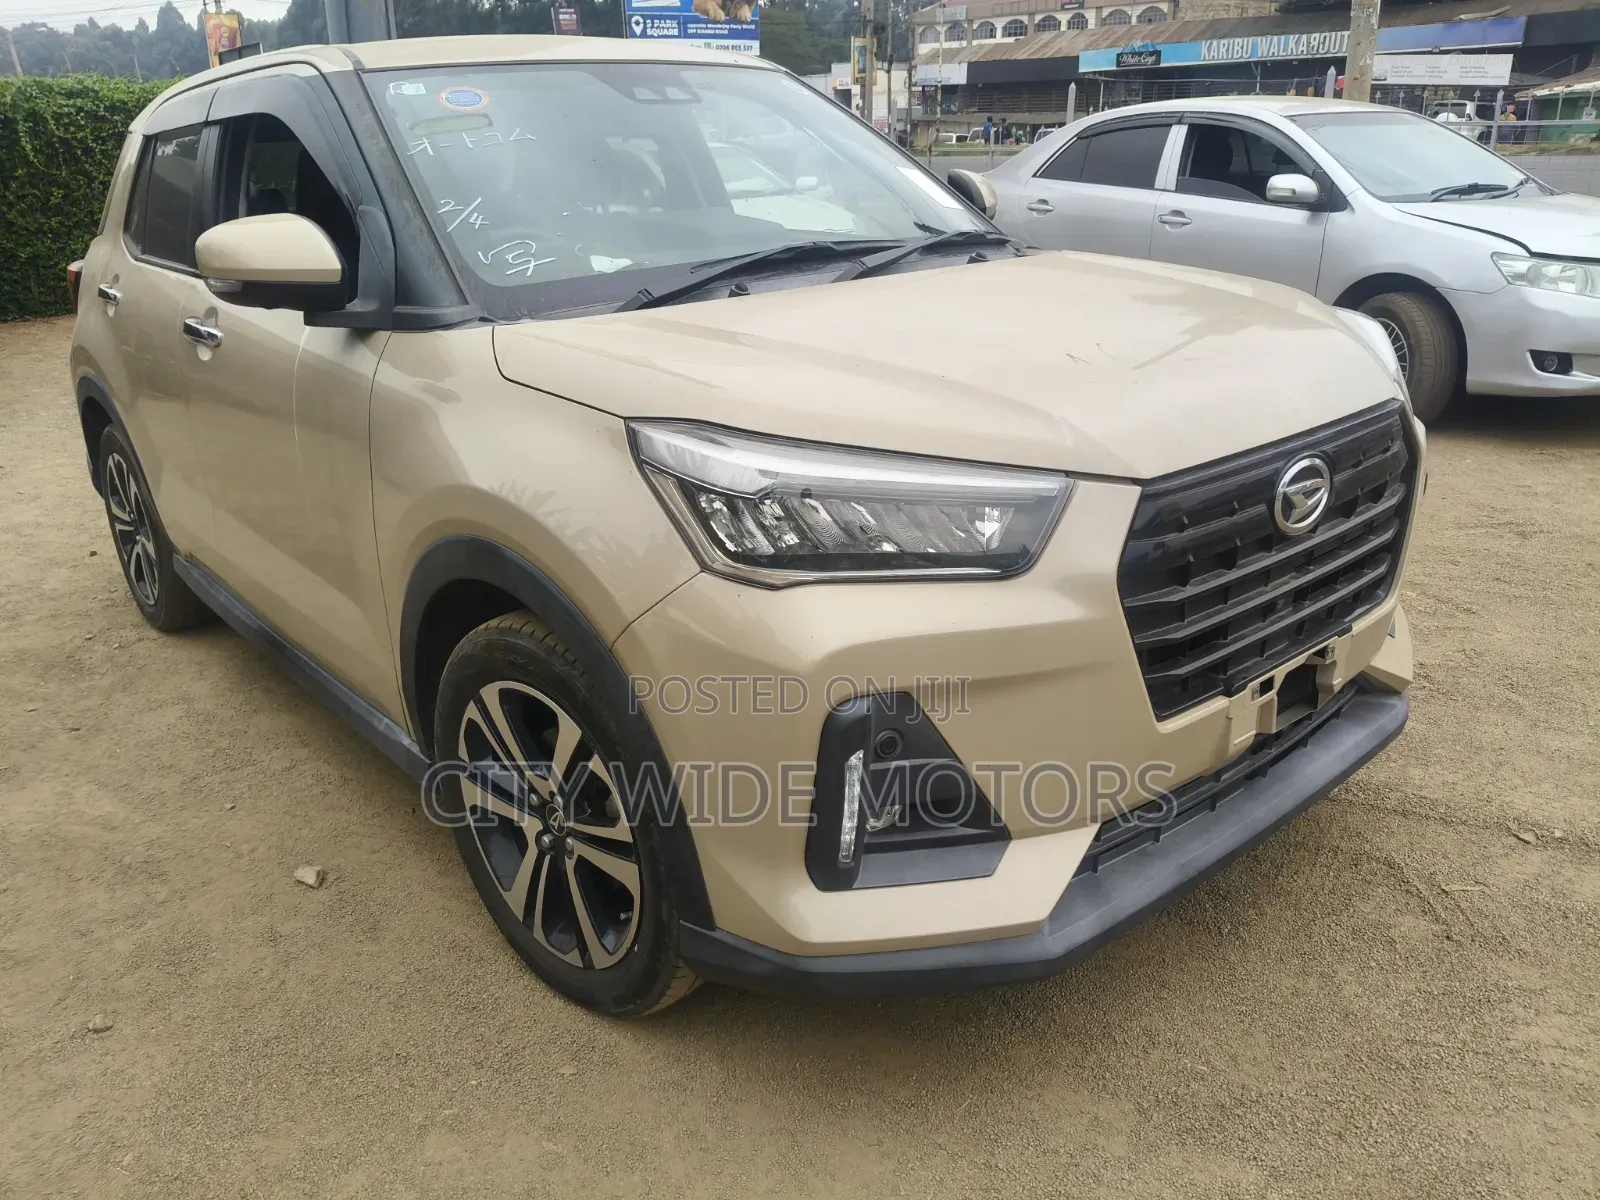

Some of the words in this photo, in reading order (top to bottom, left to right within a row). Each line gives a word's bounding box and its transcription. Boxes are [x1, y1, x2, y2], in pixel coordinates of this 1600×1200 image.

[653, 19, 678, 28] PARK
[646, 28, 679, 36] SQUARE
[1200, 37, 1253, 62] KARIBU
[1119, 53, 1140, 65] White
[1140, 51, 1157, 66] Cap
[436, 197, 490, 232] 2/4
